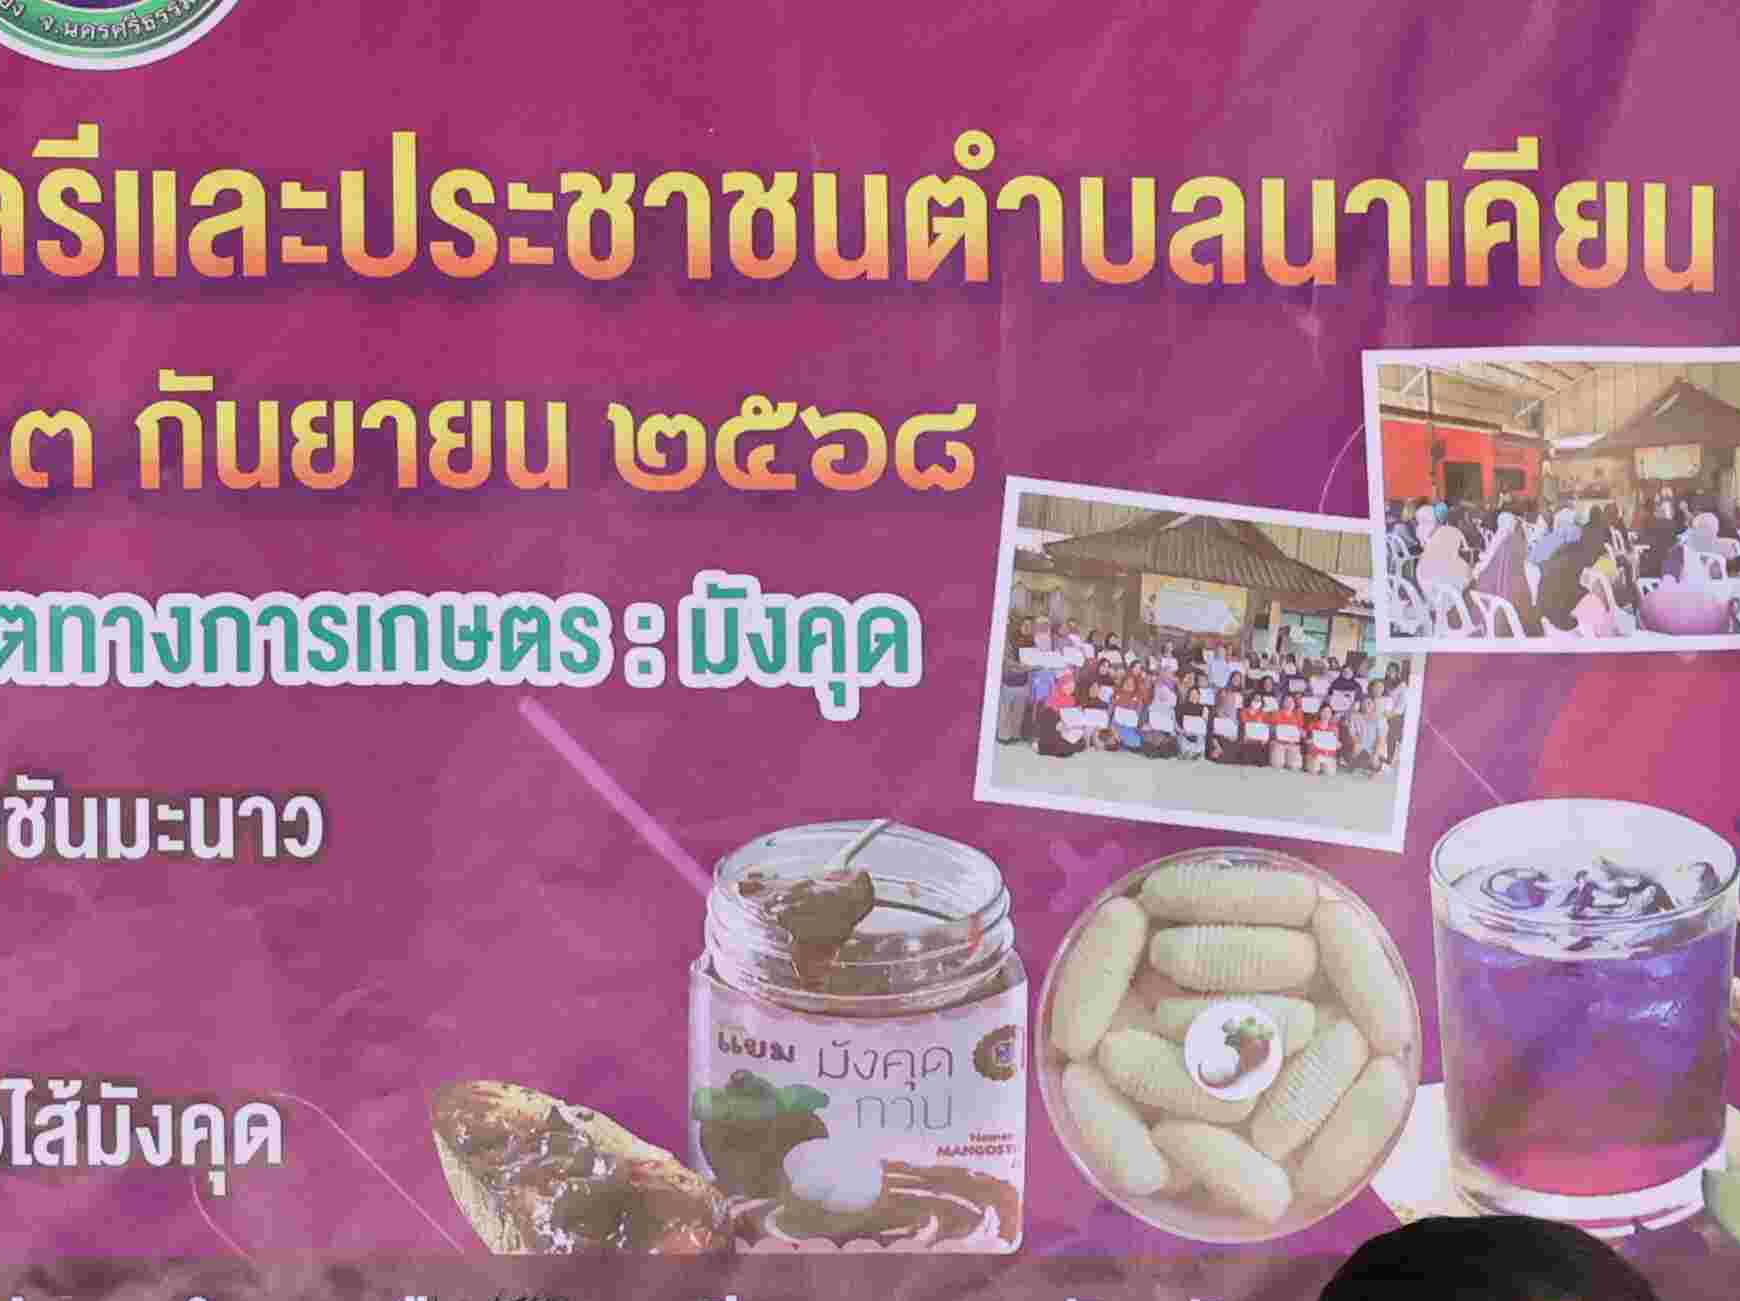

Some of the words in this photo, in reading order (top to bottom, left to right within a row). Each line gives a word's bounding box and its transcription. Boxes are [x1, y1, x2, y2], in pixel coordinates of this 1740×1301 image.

[135, 370, 568, 489] กันยายน
[607, 394, 977, 491] ๒๕๖๘
[687, 578, 914, 708] มังคุด
[817, 1039, 953, 1092] มังคุด
